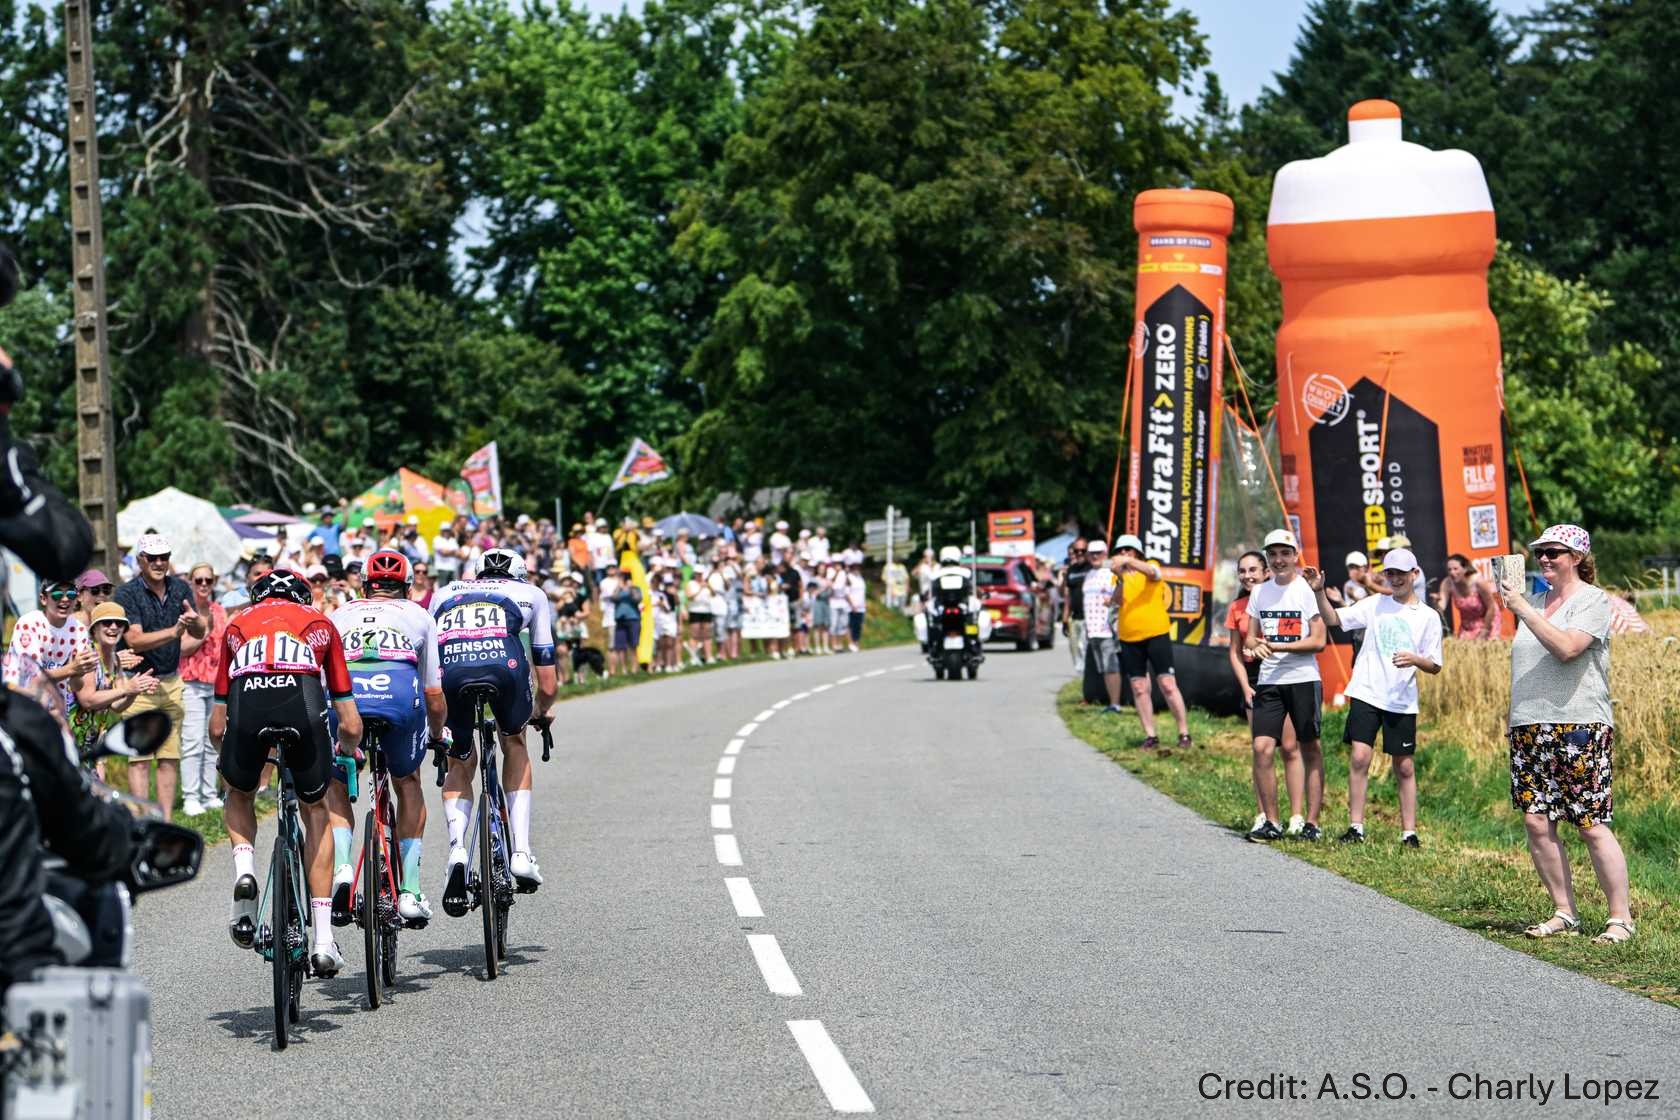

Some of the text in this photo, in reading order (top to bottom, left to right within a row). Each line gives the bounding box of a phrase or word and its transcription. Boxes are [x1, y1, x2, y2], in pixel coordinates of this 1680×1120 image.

[1184, 316, 1195, 366] VITAMINS
[1155, 323, 1176, 391] ZERO
[1184, 366, 1194, 391] AND
[1183, 391, 1194, 434] SODIUM
[1195, 409, 1206, 459] Zero sugar
[442, 607, 500, 632] 54 54
[305, 629, 331, 650] ARKEA
[342, 629, 413, 651] 18 218
[444, 640, 505, 656] RENSON
[232, 639, 264, 671] 174
[279, 635, 314, 664] 174
[443, 651, 508, 665] OUTDOOR
[243, 675, 297, 692] ARKEA
